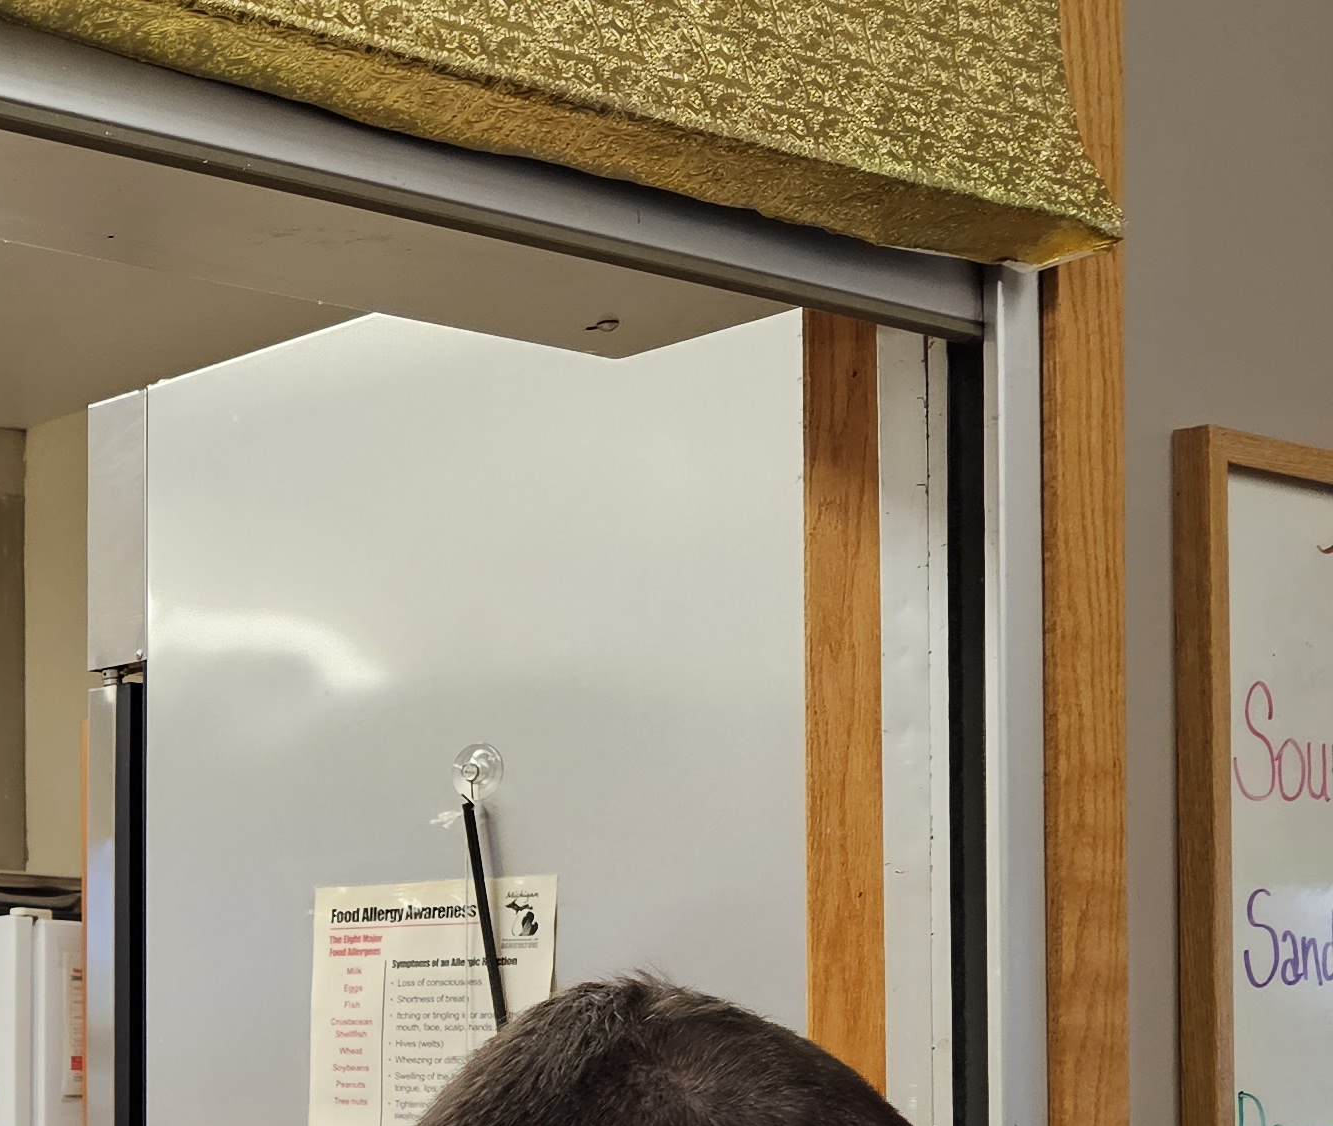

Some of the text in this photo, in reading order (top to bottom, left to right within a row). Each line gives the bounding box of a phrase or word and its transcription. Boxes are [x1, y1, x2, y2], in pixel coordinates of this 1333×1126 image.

[505, 890, 540, 904] Michigan
[331, 903, 477, 924] Food Allergy Awareness
[329, 933, 383, 945] The Eight Major
[329, 946, 381, 957] Food Allergens
[392, 959, 431, 969] Symptoms
[432, 958, 439, 967] of
[440, 959, 450, 967] an
[346, 967, 362, 975] Milk
[397, 979, 415, 987] Loss
[417, 978, 425, 987] of
[343, 984, 363, 993] Eggs
[396, 994, 435, 1003] Shortness
[437, 994, 445, 1003] of
[396, 1012, 421, 1021] Itching
[432, 1012, 460, 1021] tingling
[330, 1018, 373, 1026] Crustacean
[335, 1030, 368, 1038] Shellfish
[418, 1039, 445, 1049] (welts)
[339, 1047, 363, 1055] Wheat
[395, 1055, 433, 1065] Wheezing
[332, 1064, 370, 1073] Soybeans
[394, 1072, 426, 1081] Swelling
[427, 1072, 435, 1080] of
[335, 1080, 366, 1089] Peanuts
[334, 1097, 368, 1106] Tree nuts
